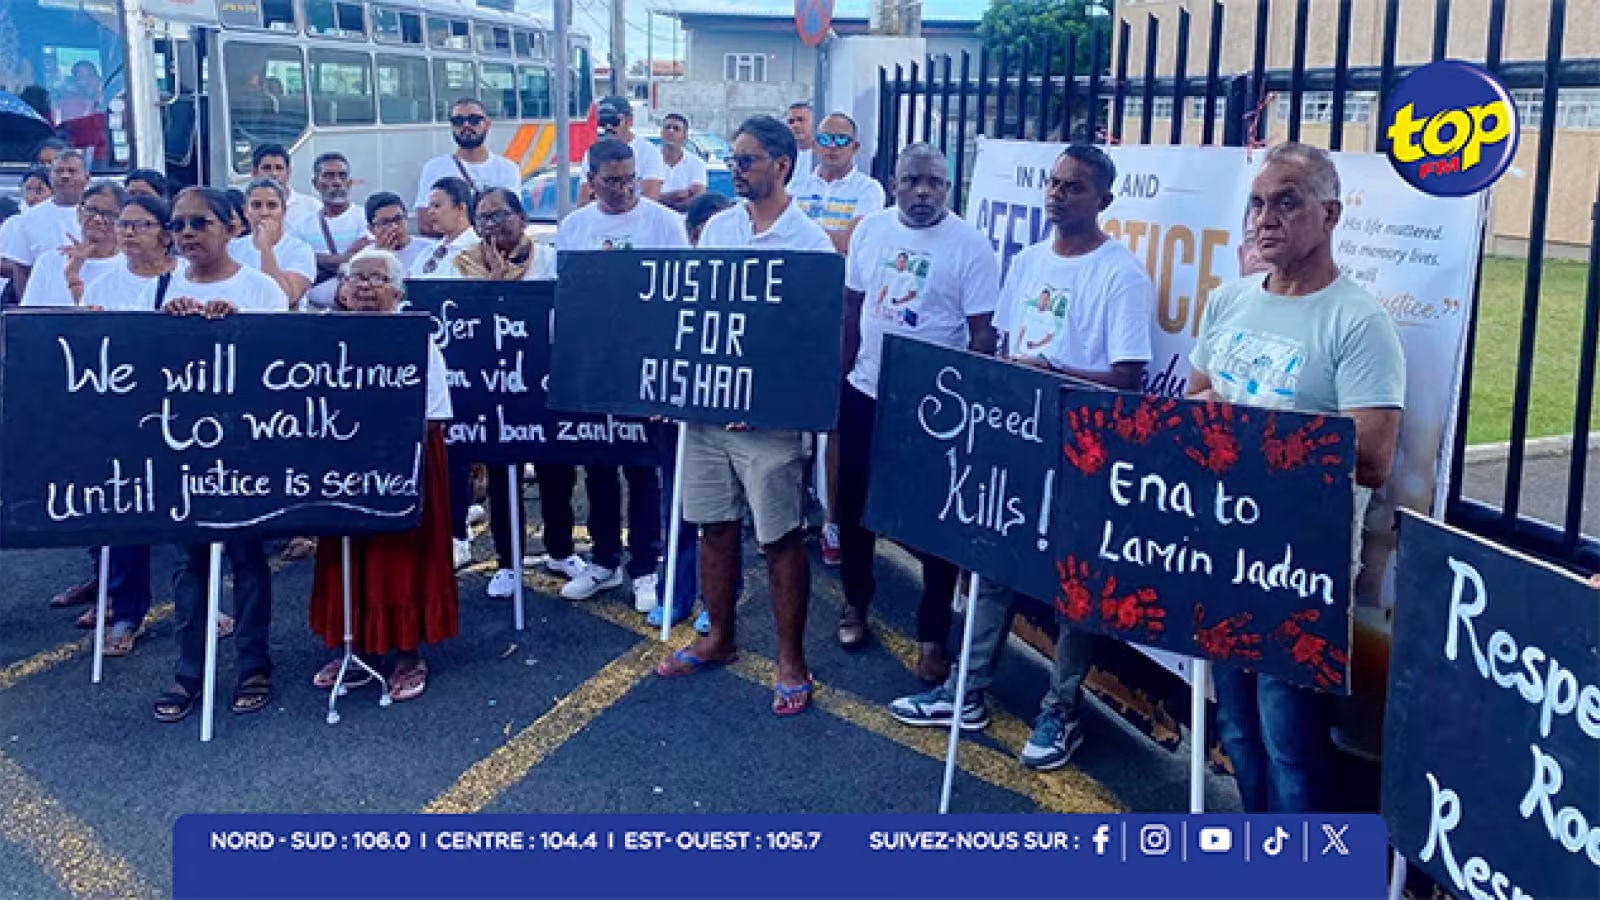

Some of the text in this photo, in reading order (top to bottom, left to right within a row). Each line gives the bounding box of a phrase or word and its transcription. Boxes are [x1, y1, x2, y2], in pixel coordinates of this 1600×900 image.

[1016, 166, 1034, 187] IN
[1118, 173, 1160, 198] AND
[639, 257, 785, 304] JUSTICE
[493, 312, 529, 351] pa
[674, 310, 748, 357] FOR
[58, 336, 421, 395] We will continue
[481, 348, 529, 393] vid
[639, 357, 753, 412] RISHAN
[138, 396, 360, 451] to walk
[496, 404, 547, 443] ban
[917, 366, 1044, 453] Speed
[47, 442, 422, 522] until justice is served
[1109, 460, 1261, 525] Ena to
[1231, 543, 1336, 605] Jadan
